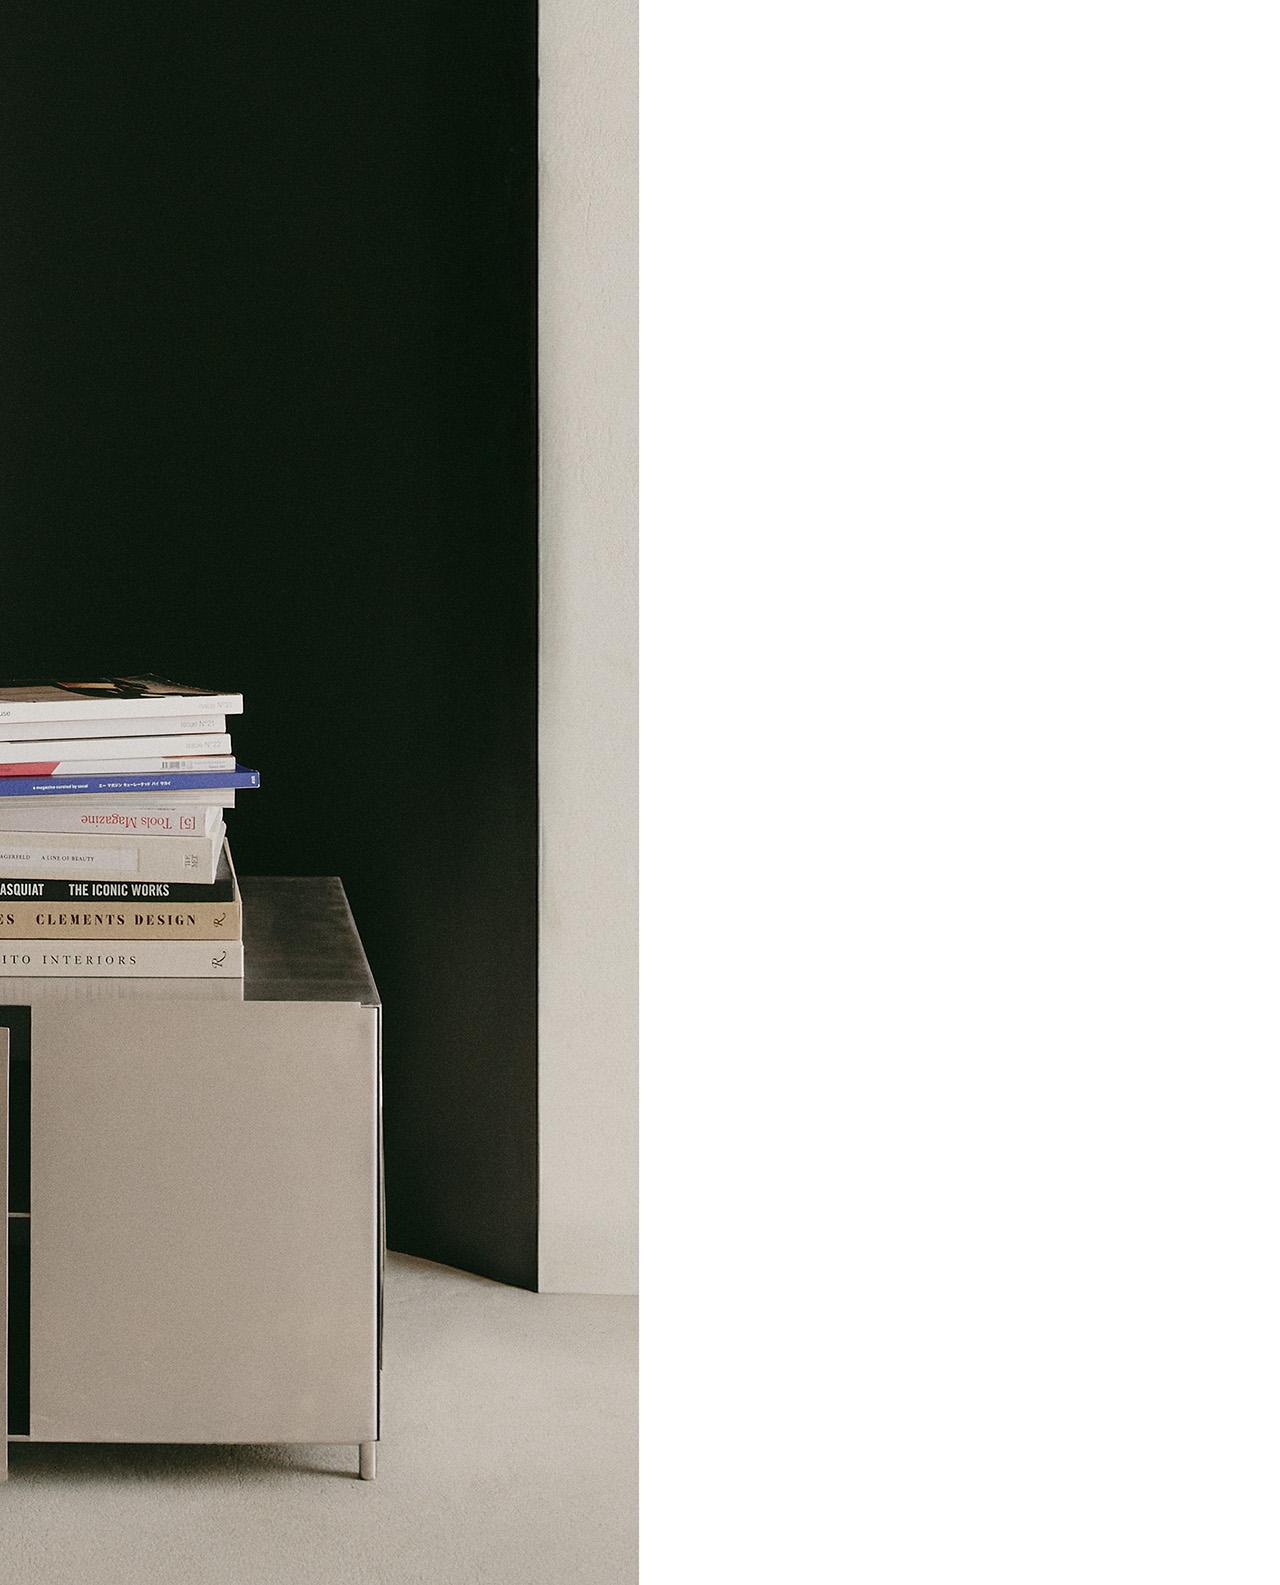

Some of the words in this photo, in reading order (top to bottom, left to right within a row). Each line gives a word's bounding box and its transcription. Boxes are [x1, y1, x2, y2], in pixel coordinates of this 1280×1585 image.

[81, 814, 137, 828] Magazine
[141, 815, 172, 829] Tools
[179, 816, 196, 830] [5]
[68, 883, 88, 896] THE
[92, 883, 129, 897] ICONIC
[131, 884, 170, 897] WORKS
[36, 913, 125, 926] CLEMENTS
[134, 914, 196, 926] DESIGN
[43, 955, 137, 965] INTERIORS
